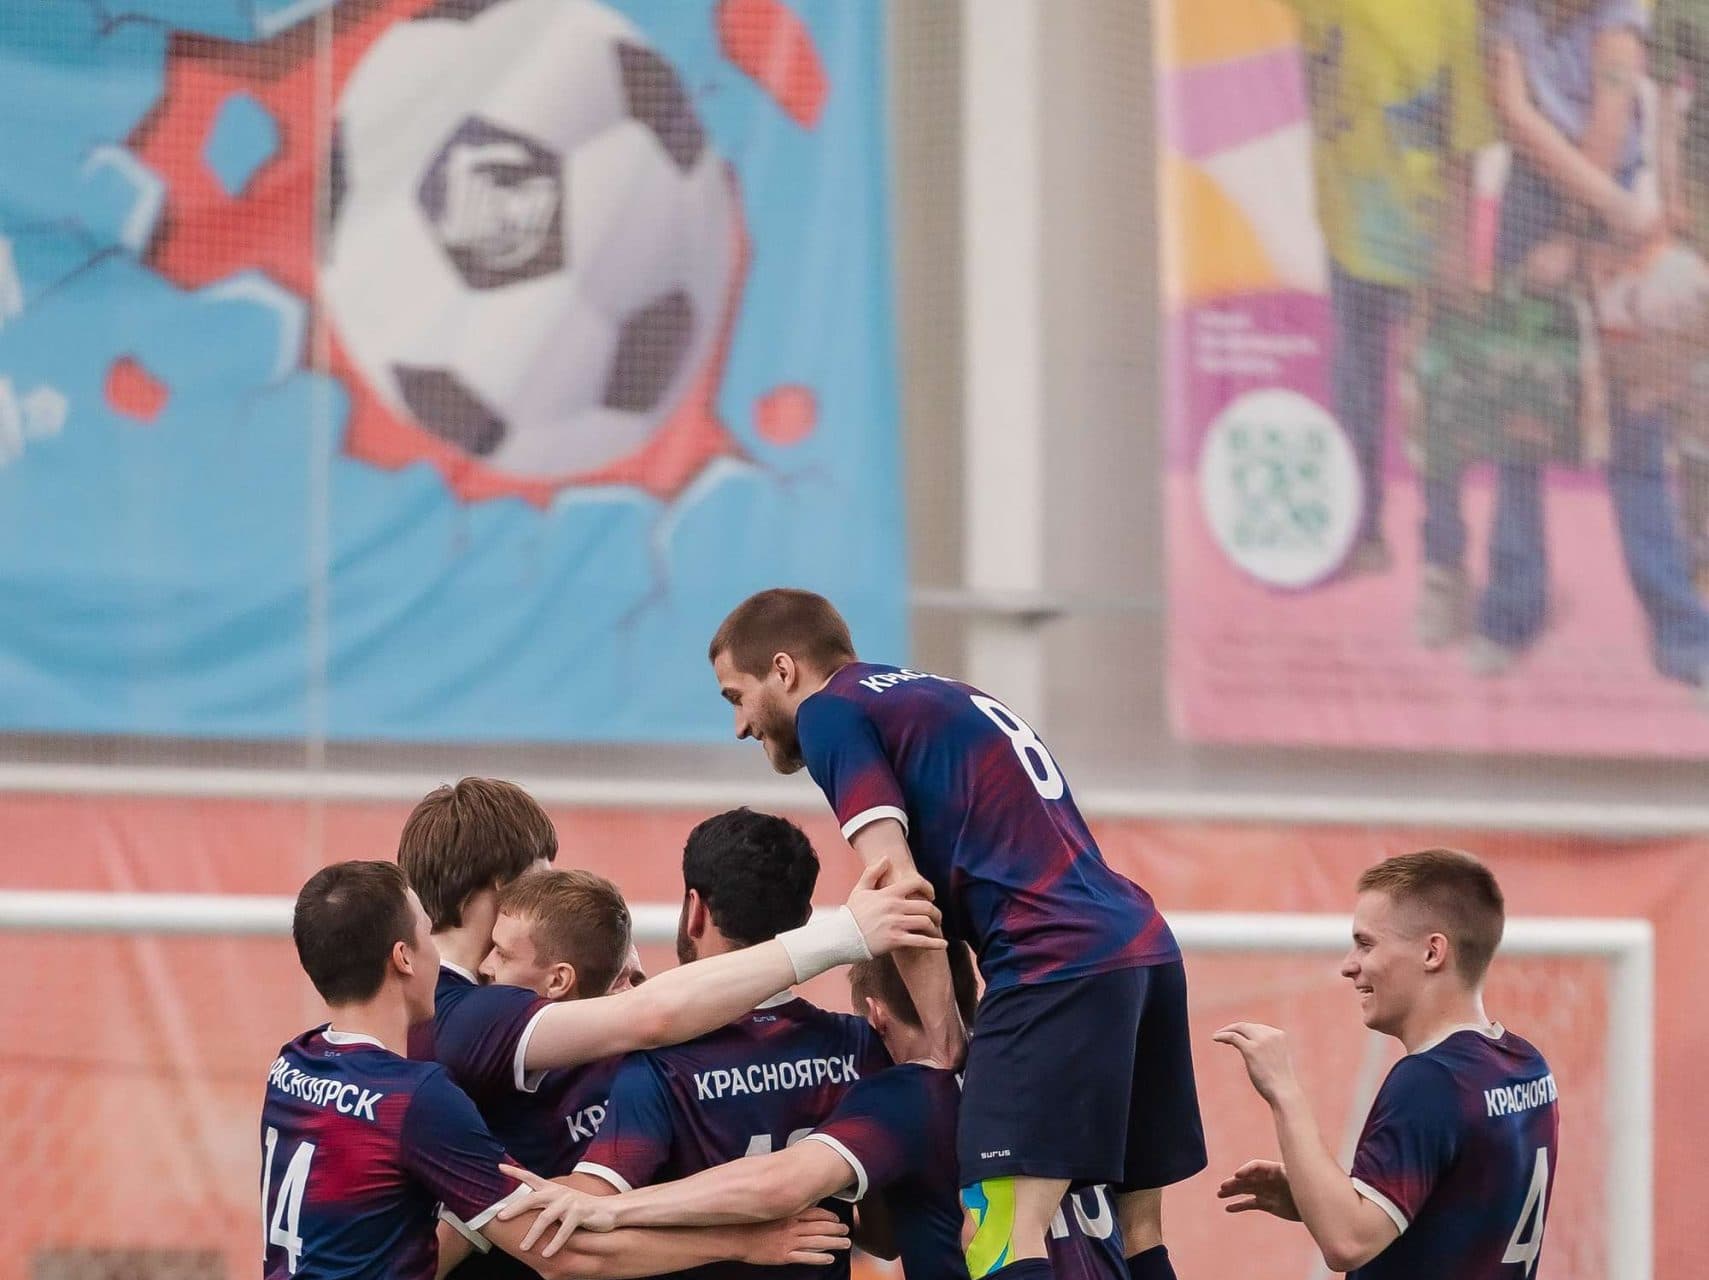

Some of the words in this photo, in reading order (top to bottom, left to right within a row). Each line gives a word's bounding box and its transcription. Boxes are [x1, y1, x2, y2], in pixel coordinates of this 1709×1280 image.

[969, 694, 1064, 800] 8
[267, 1056, 383, 1121] РАСНОЯРСК
[693, 1054, 861, 1100] КРАСНОЯРСК
[262, 1126, 316, 1275] 14
[1501, 1146, 1549, 1278] 4
